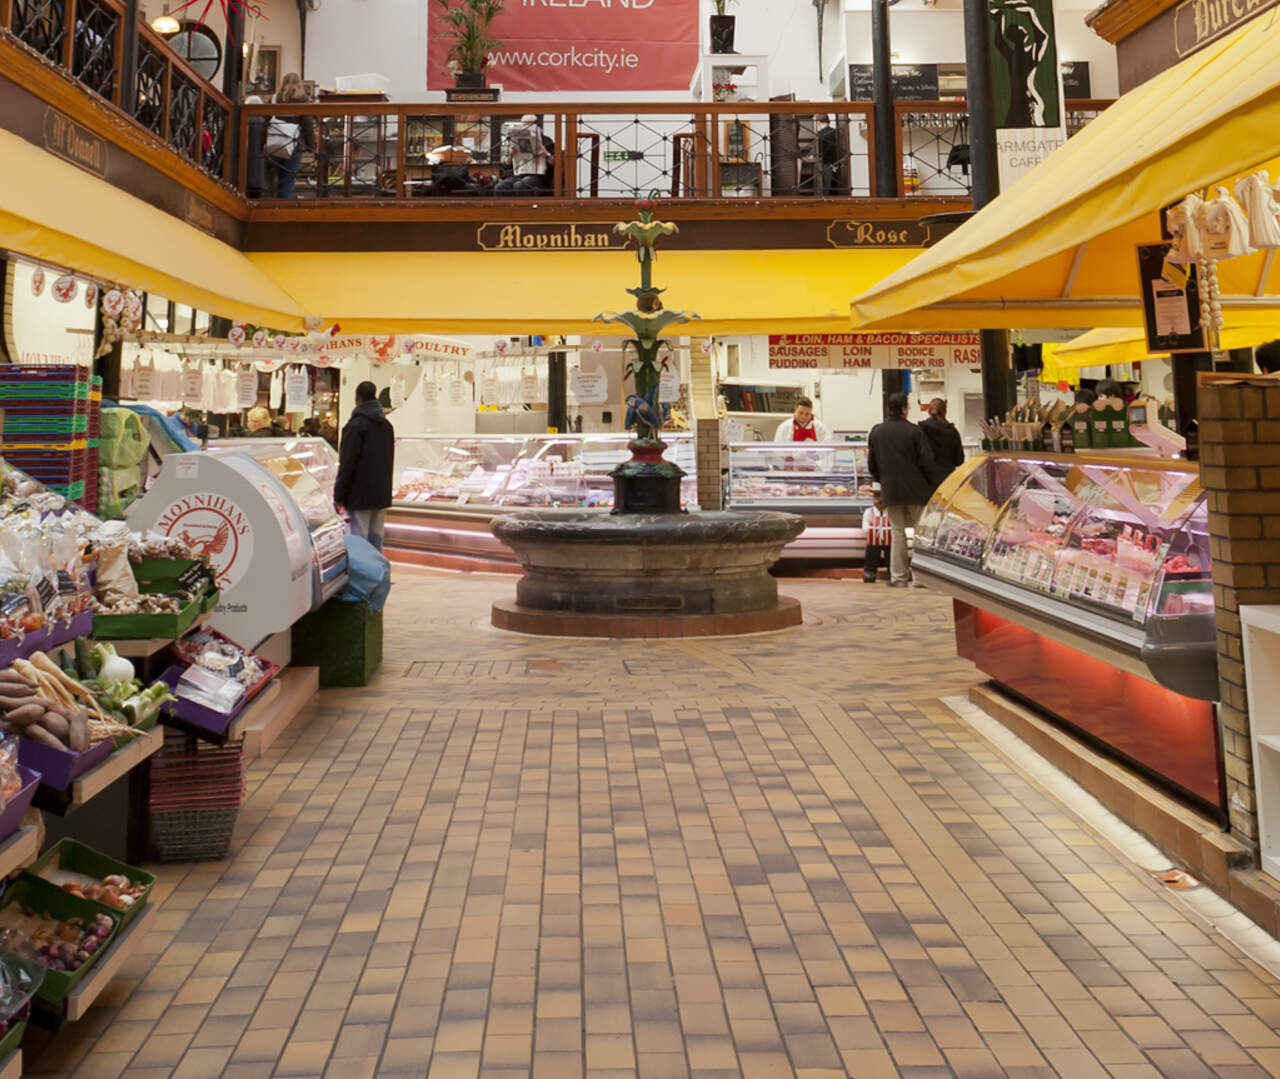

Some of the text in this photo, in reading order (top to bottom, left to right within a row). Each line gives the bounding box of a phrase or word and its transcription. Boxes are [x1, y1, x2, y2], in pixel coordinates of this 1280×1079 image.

[487, 46, 639, 73] www.corkcity.ie
[997, 140, 1063, 153] ARMGATE
[496, 223, 609, 249] Moynihan
[846, 221, 908, 243] Rose
[827, 334, 855, 345] HAM
[856, 334, 867, 344] &
[869, 334, 908, 344] BACON
[910, 334, 980, 345] SPECIALISTS
[415, 340, 470, 357] OULTRY
[769, 347, 828, 357] SAUSAGES
[843, 347, 872, 356] LOIN
[898, 347, 935, 357] BODICE
[769, 358, 818, 368] PUDDING
[843, 358, 871, 367] HAM
[898, 358, 945, 368] PORK RIB
